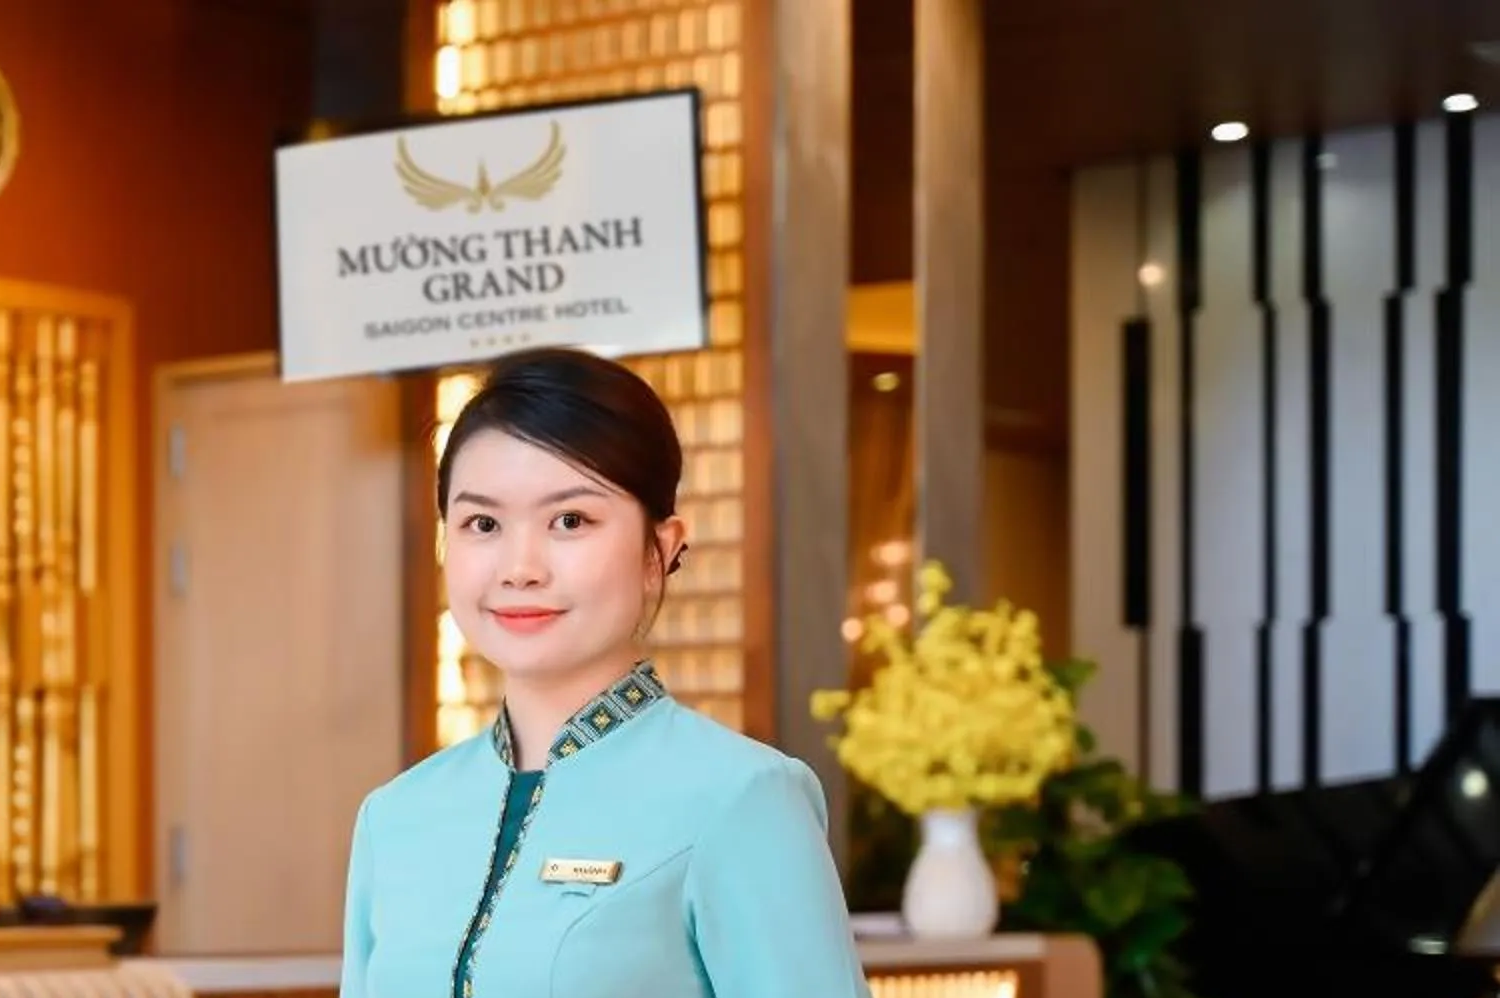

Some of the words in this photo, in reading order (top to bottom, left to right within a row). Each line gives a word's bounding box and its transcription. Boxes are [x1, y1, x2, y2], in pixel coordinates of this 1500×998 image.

[338, 231, 488, 278] MƯỜNG
[494, 216, 642, 260] THANH
[422, 261, 565, 304] GRAND
[364, 315, 451, 338] SAIGON
[456, 304, 546, 330] CENTRE
[554, 297, 630, 319] HOTEL
